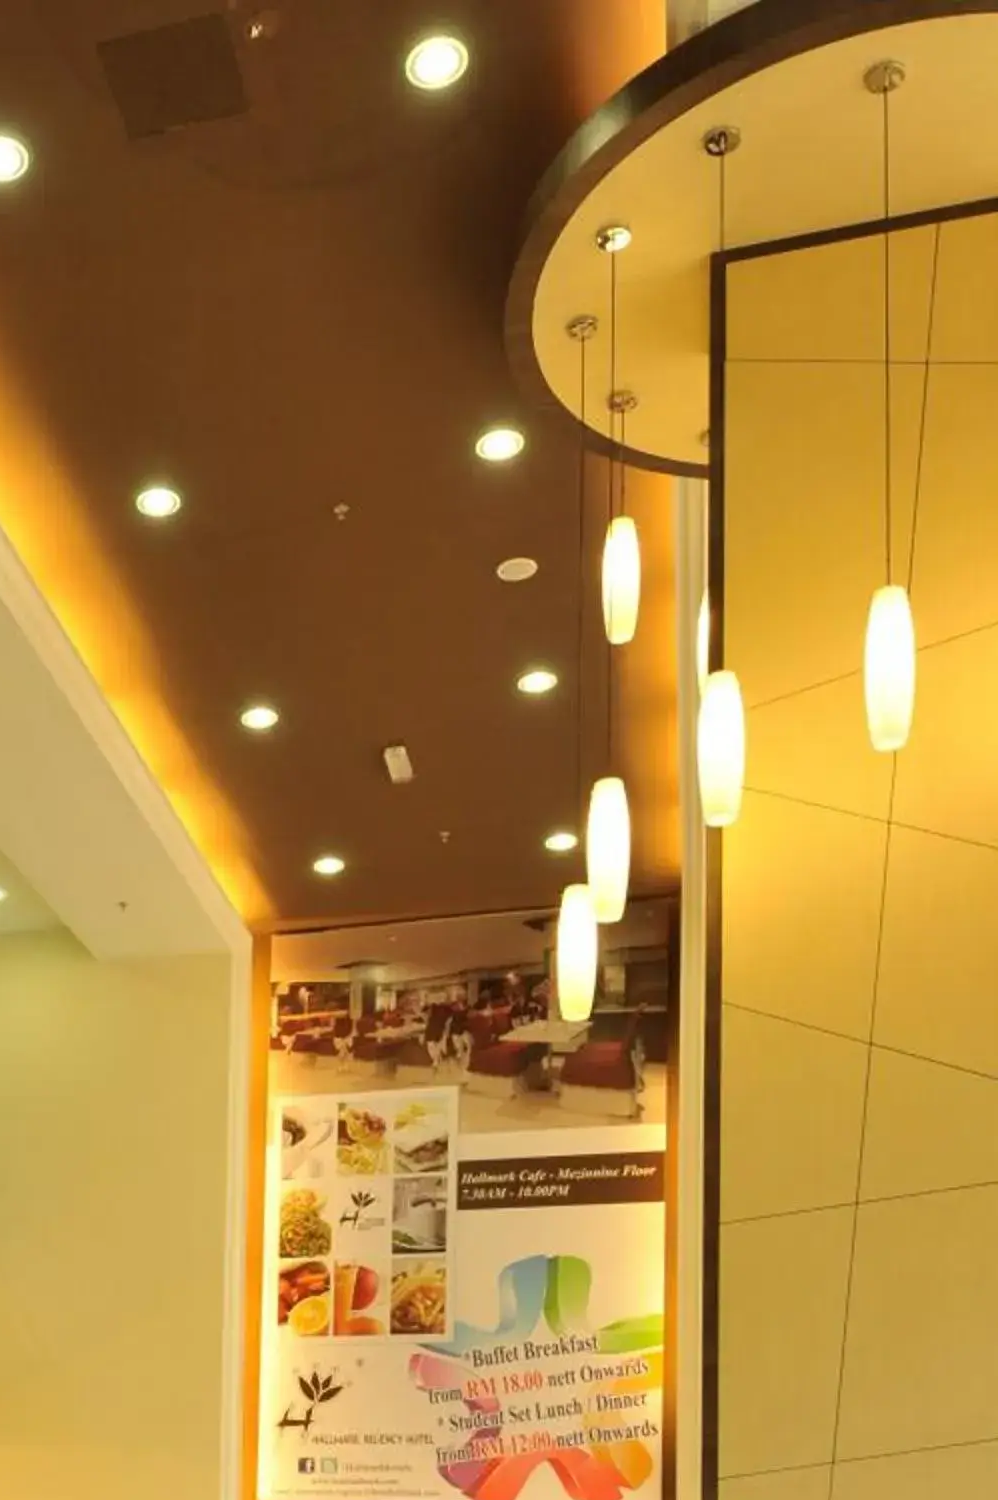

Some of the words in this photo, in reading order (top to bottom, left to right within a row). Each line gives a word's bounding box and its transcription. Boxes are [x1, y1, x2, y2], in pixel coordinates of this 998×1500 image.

[519, 1167, 547, 1184] Cafe
[622, 1162, 657, 1178] Floor
[524, 1333, 600, 1360] Breakfast
[429, 1388, 463, 1407] from
[466, 1378, 501, 1402] RM
[503, 1370, 544, 1394] 18.00
[547, 1372, 576, 1388] nett
[579, 1360, 650, 1383] Onwards
[449, 1407, 504, 1433] Student
[508, 1404, 532, 1423] Set
[535, 1399, 583, 1421] Lunch
[596, 1390, 647, 1412] Dinner
[588, 1419, 659, 1444] Onwards
